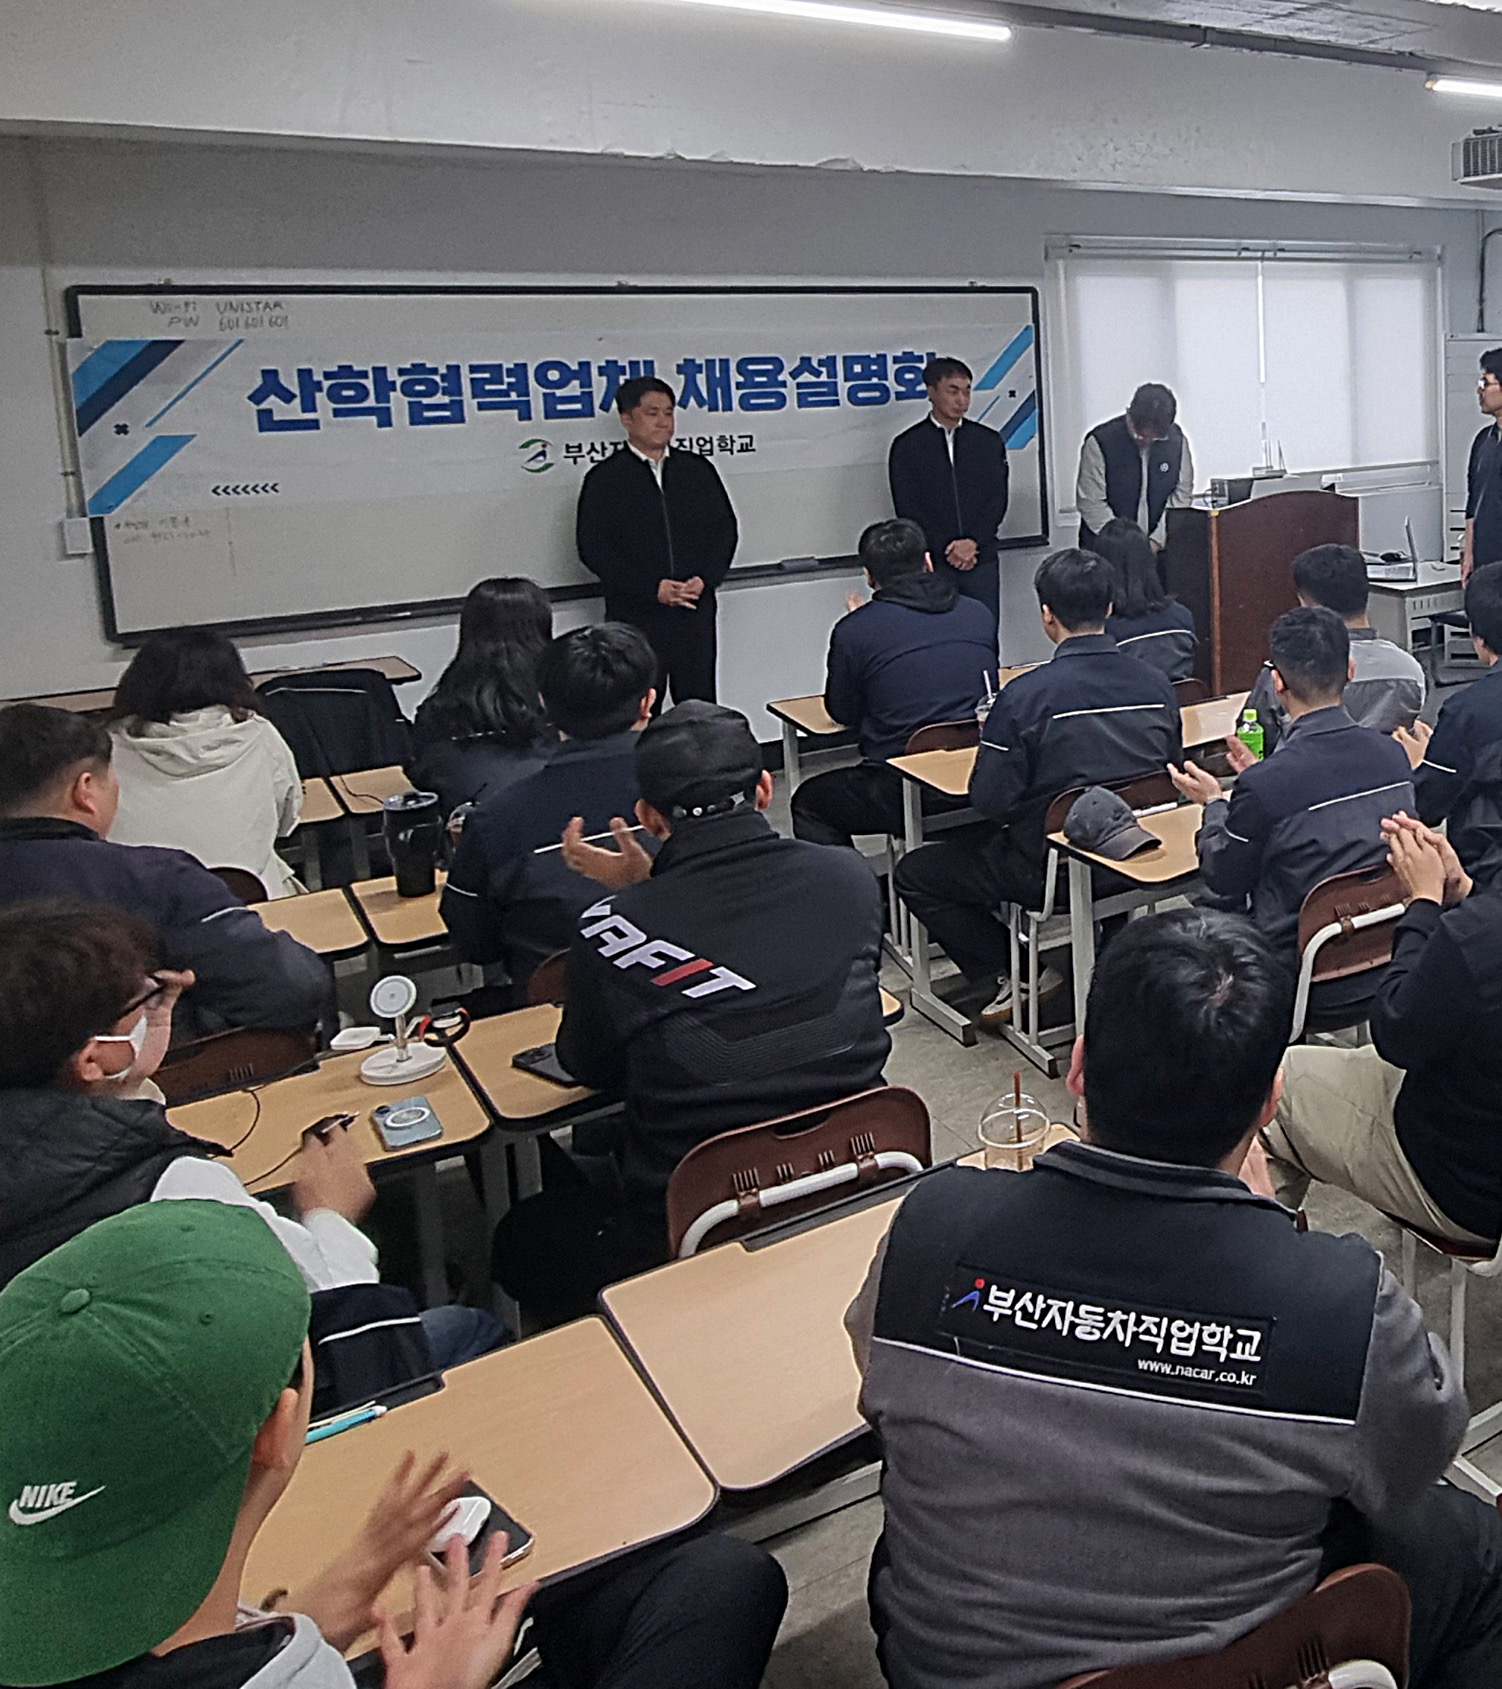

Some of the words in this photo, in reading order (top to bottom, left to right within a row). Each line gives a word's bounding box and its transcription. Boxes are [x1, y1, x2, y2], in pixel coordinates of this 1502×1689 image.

[563, 434, 756, 465] 부산직업학교
[983, 1284, 1262, 1363] 부산자동차직업학교
[1137, 1359, 1257, 1386] www.nacar.co.kr
[19, 1481, 77, 1509] NIKE
